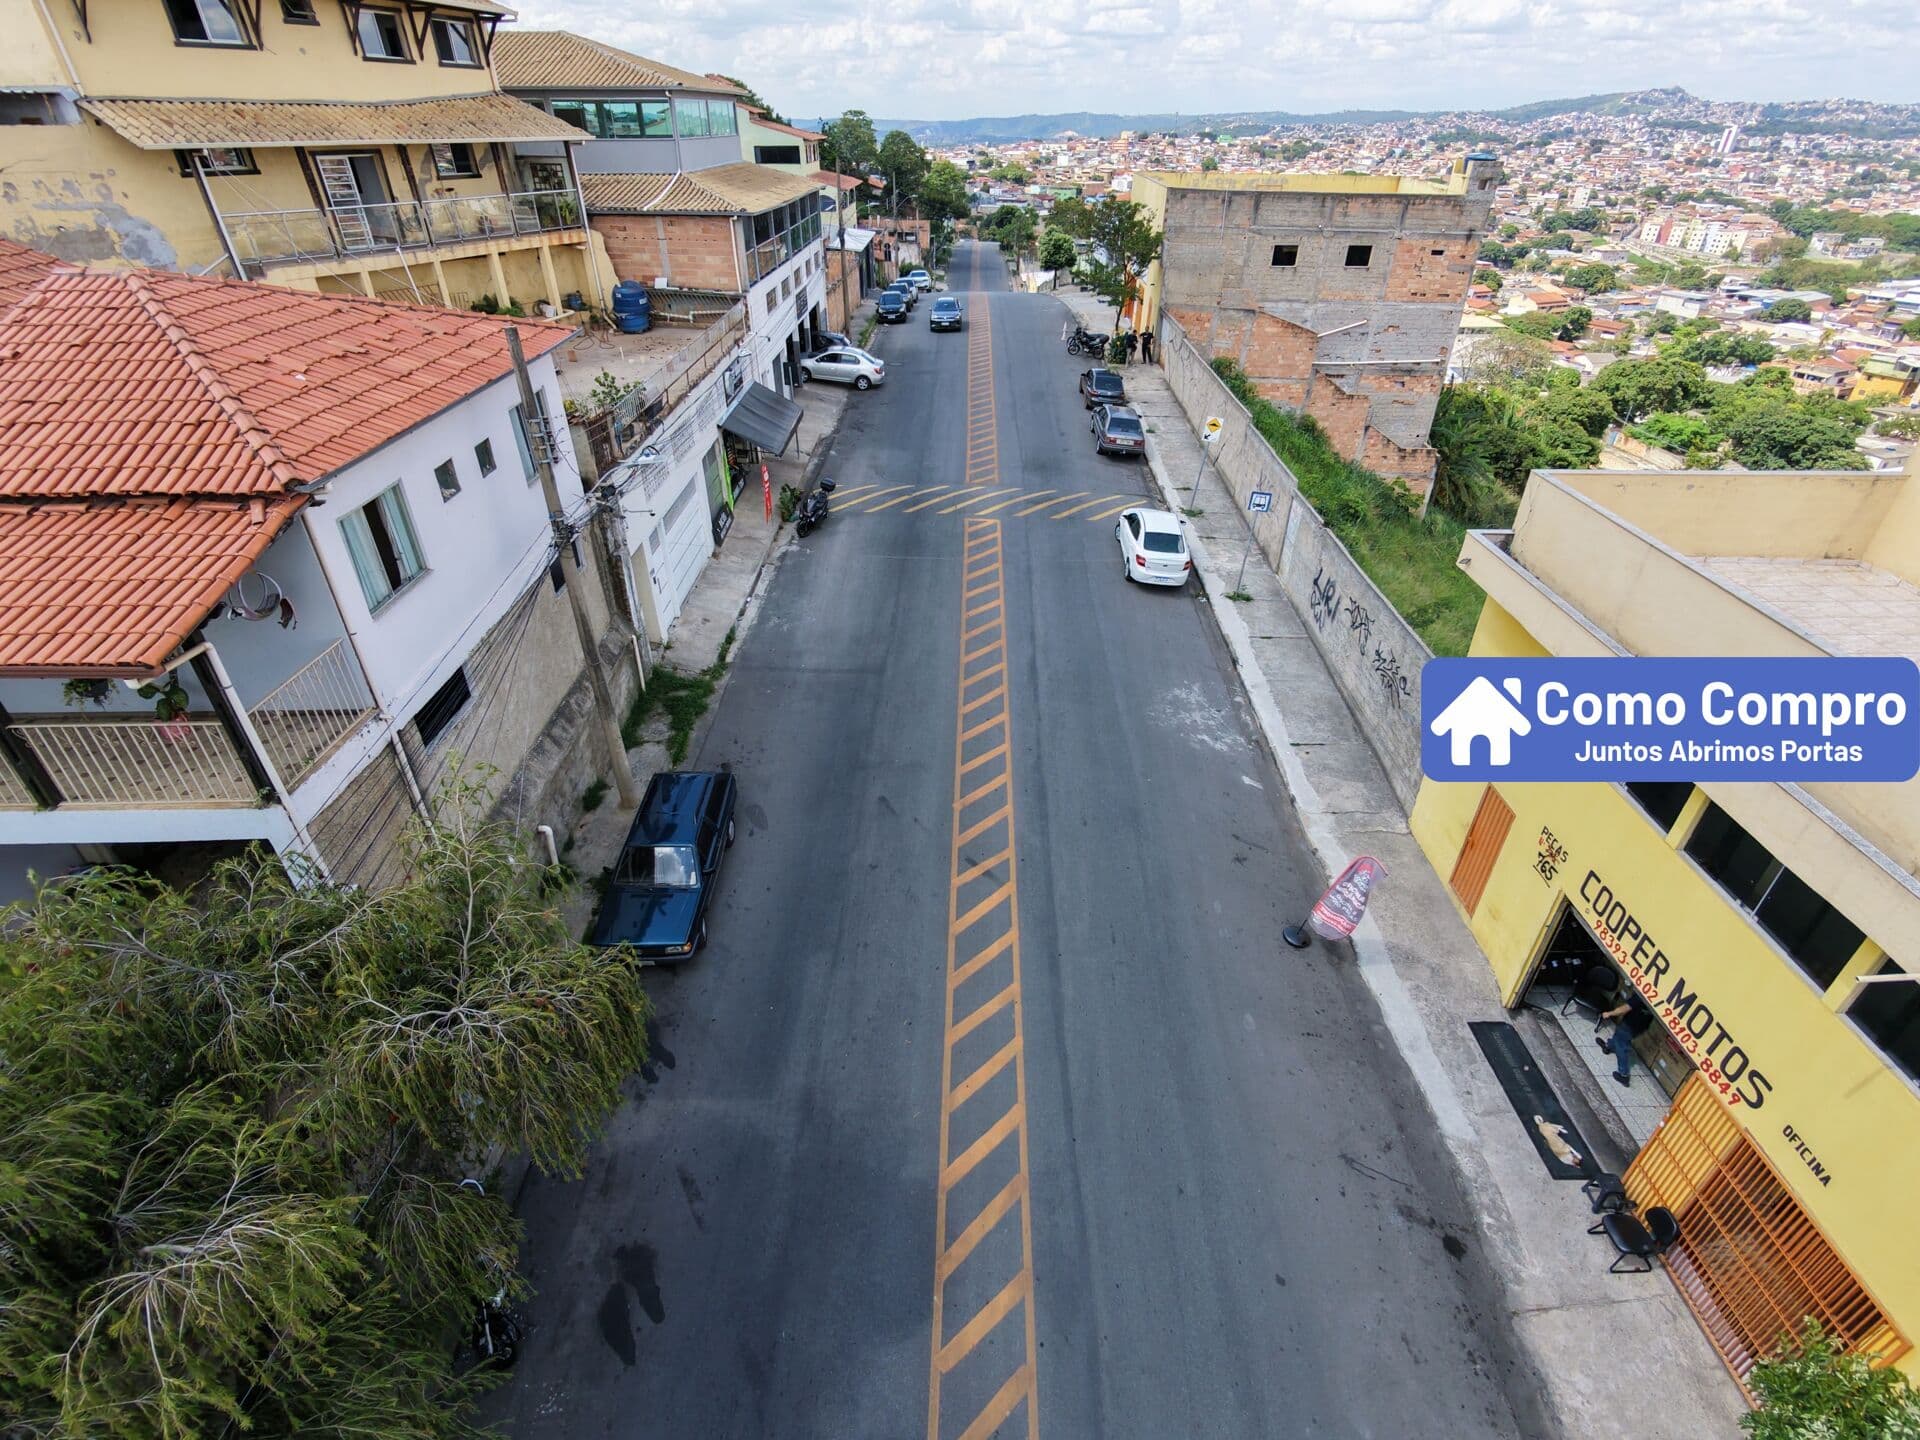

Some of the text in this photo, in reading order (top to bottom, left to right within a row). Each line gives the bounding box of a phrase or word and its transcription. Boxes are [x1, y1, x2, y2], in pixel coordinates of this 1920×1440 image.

[1536, 851, 1559, 881] 765
[1580, 869, 1773, 1110] COOPER MOTOS
[1782, 1124, 1833, 1188] OFICINA
